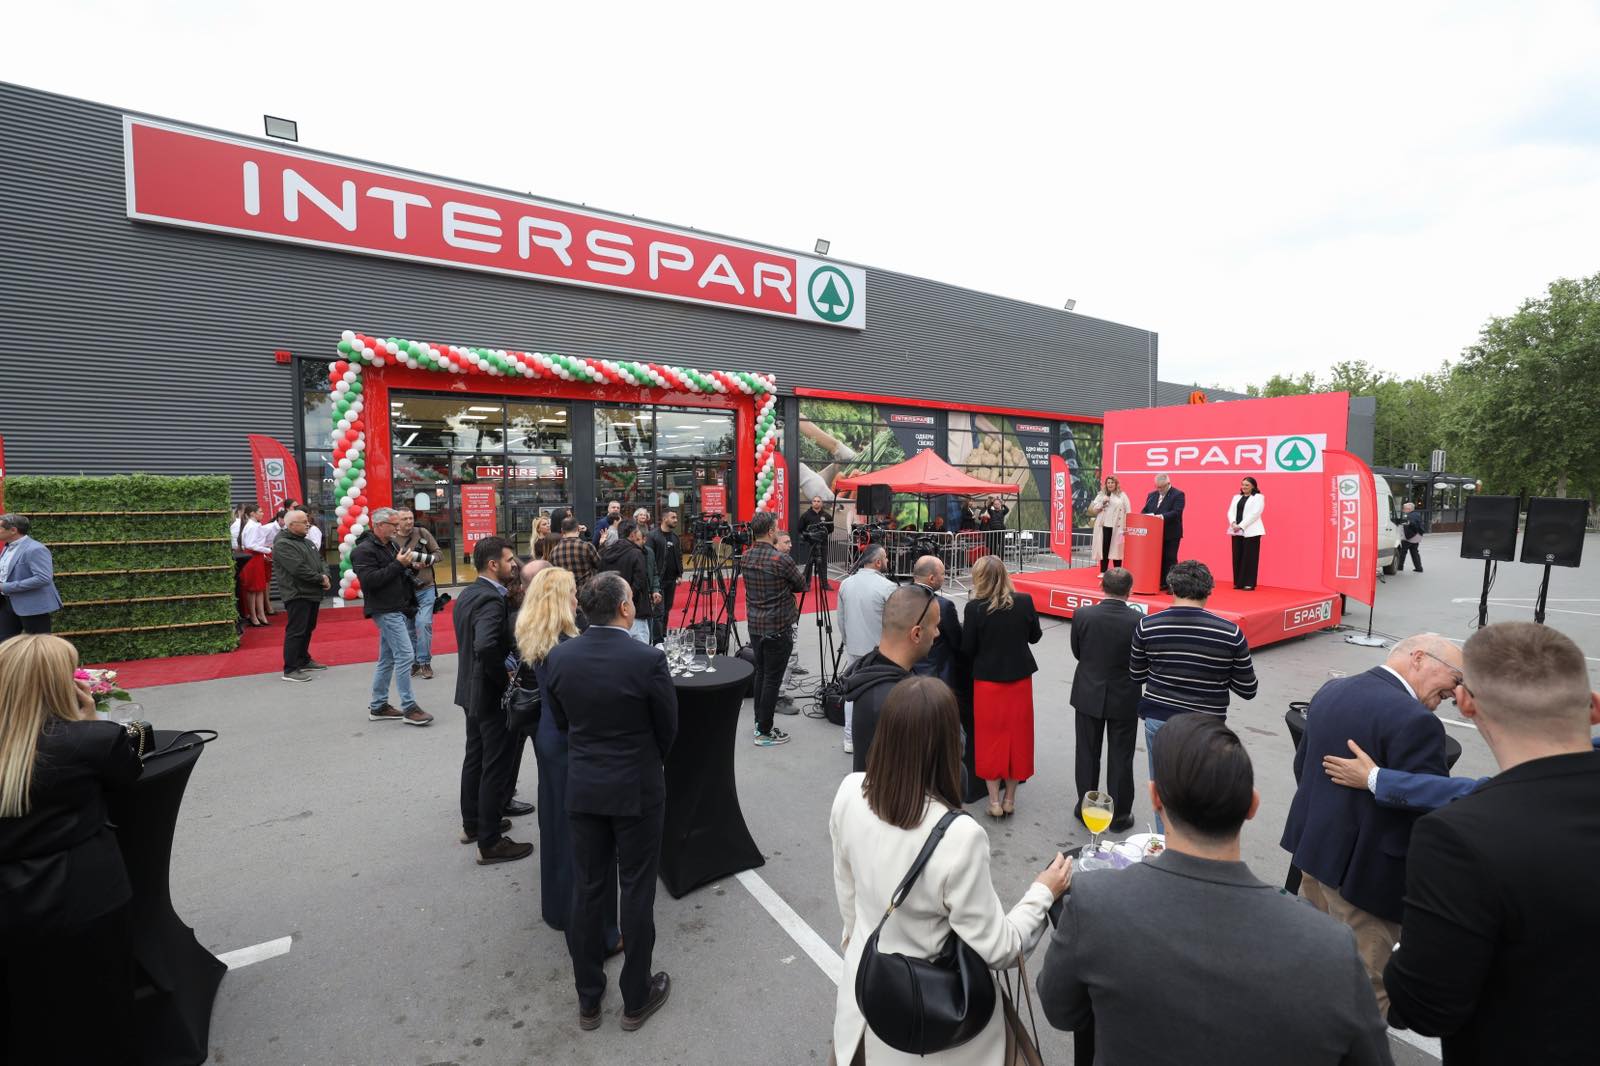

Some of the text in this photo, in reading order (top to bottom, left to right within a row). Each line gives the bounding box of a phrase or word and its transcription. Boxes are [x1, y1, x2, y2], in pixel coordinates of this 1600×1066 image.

[243, 161, 792, 302] INTERSPAR
[1146, 444, 1263, 467] SPAR
[1066, 596, 1101, 608] SP
[1294, 607, 1322, 623] SPAR
